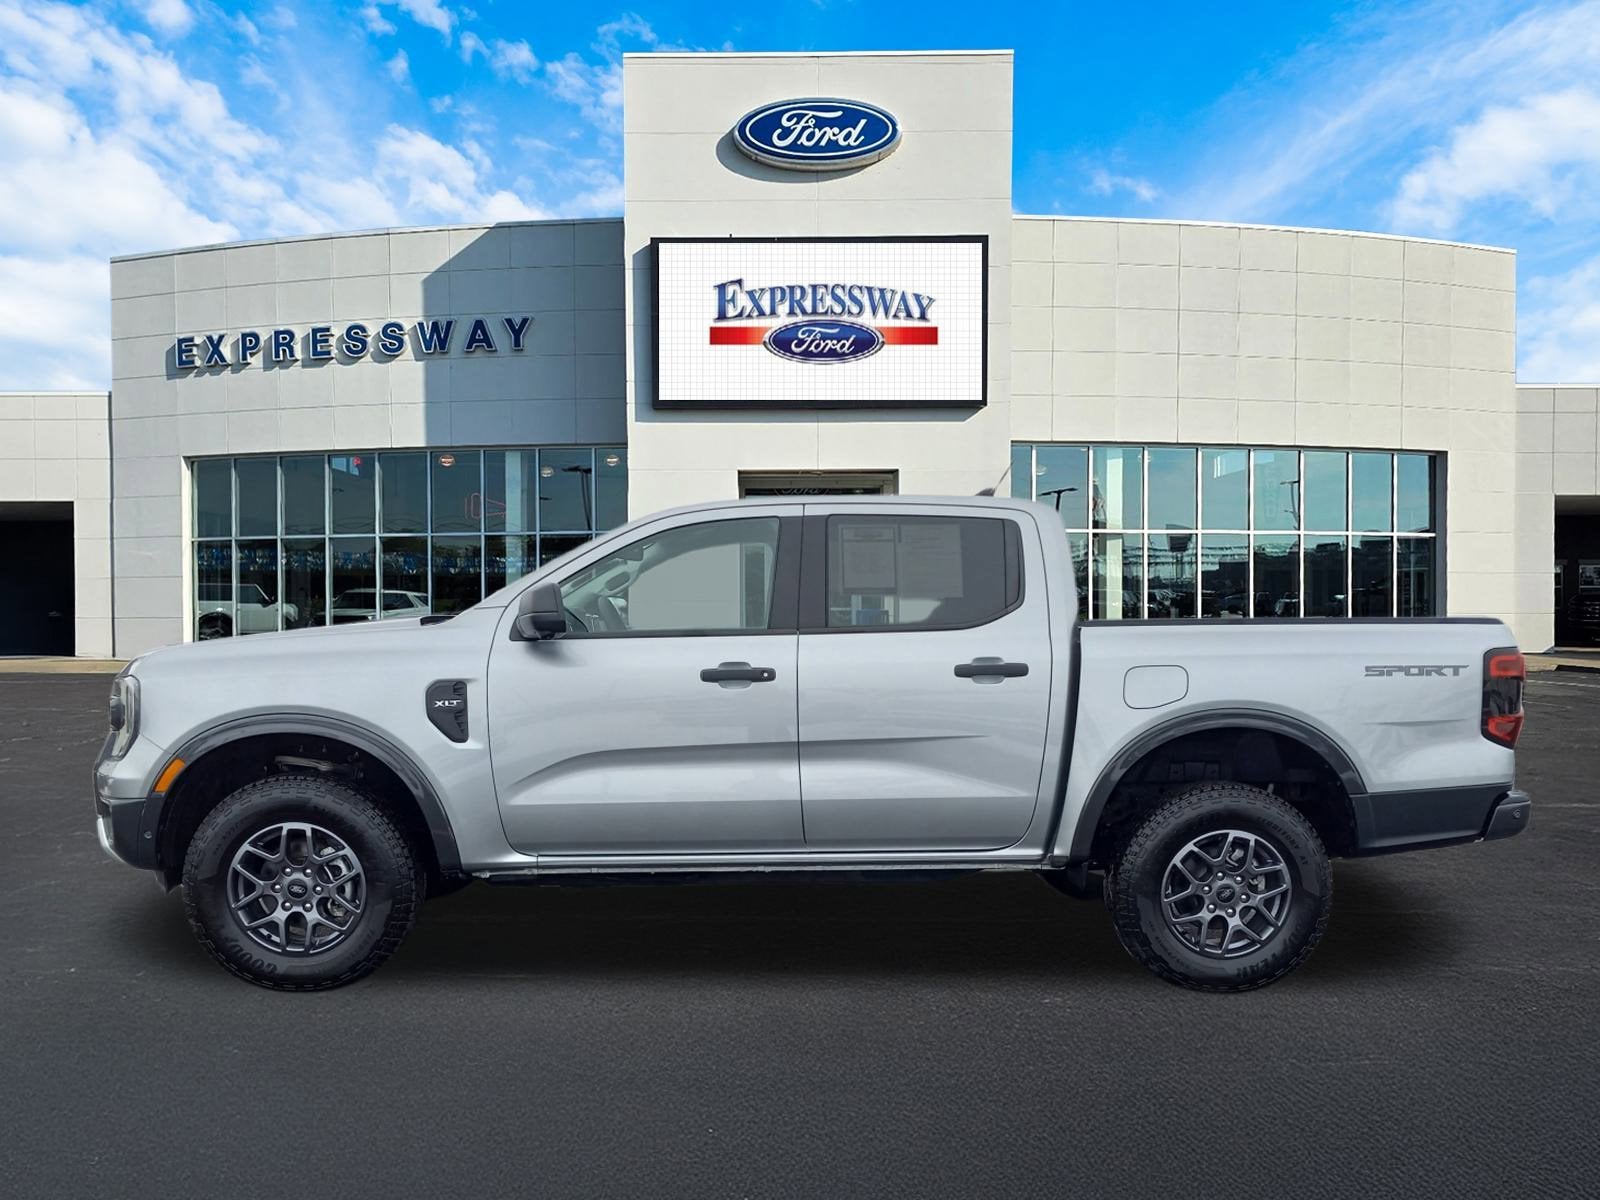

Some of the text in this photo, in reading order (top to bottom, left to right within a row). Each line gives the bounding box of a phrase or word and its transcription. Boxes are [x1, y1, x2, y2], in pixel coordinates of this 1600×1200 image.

[772, 110, 866, 147] Ford
[713, 278, 936, 323] EXPRESSWAY
[175, 315, 534, 369] EXPRESSWAY
[790, 327, 855, 354] Ford
[1364, 664, 1470, 677] SPORT
[434, 699, 463, 707] XLT
